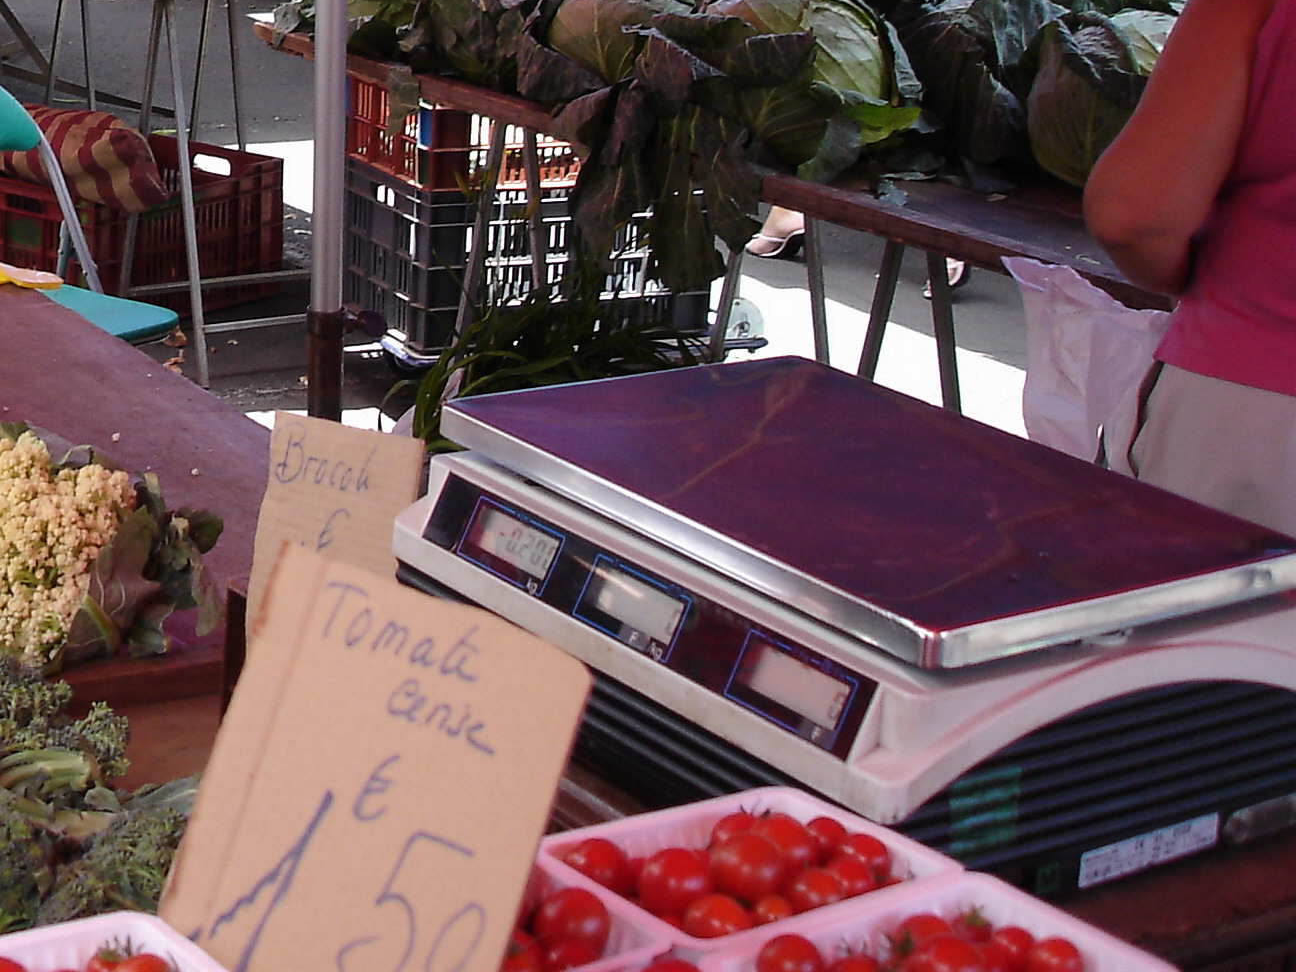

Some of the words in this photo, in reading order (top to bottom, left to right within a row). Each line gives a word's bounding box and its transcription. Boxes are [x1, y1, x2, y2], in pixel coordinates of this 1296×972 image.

[323, 581, 480, 682] Tomate
[353, 754, 401, 822] €
[337, 831, 486, 971] 50
